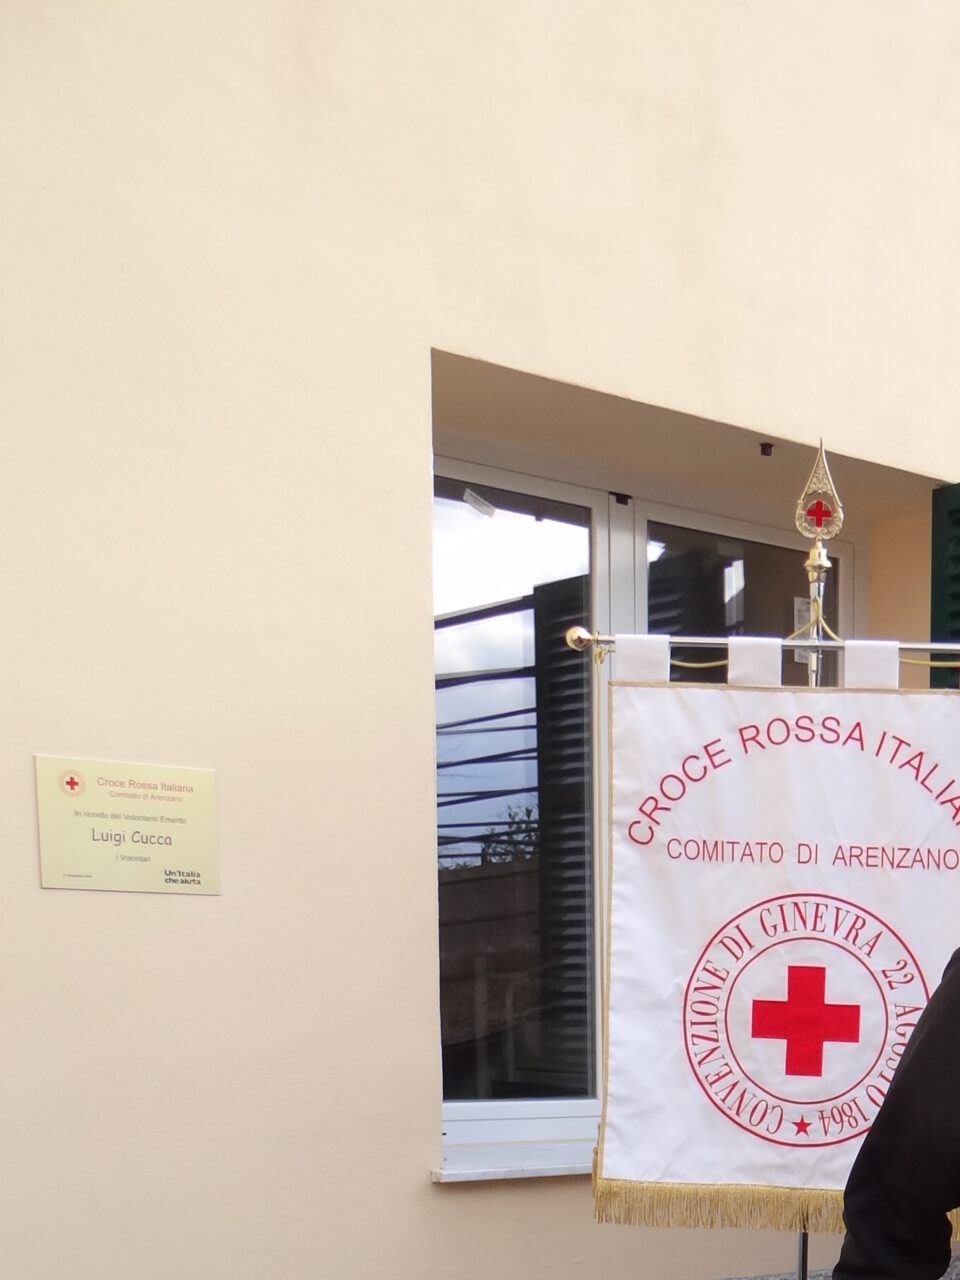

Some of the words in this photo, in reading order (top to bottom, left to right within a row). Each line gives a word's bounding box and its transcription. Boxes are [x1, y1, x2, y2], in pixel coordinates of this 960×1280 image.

[97, 777, 126, 788] Croce
[129, 780, 158, 791] Rossa
[161, 782, 193, 793] Italiana
[109, 790, 141, 800] Comitato
[627, 738, 733, 847] CROCE
[738, 715, 866, 755] ROSSA
[110, 811, 121, 820] del
[123, 813, 158, 822] Volontario
[160, 816, 187, 824] Emerito
[91, 827, 126, 846] Luigi
[131, 831, 173, 846] Cucca
[666, 837, 784, 865] COMITATO
[796, 843, 819, 865] DI
[831, 844, 960, 870] ARENZANO
[164, 877, 179, 885] che
[718, 923, 756, 963] DI
[759, 901, 884, 958] GINEVRA
[881, 959, 915, 991] 22
[690, 960, 784, 1135] CONVENZIONE
[818, 1096, 870, 1137] 1864
